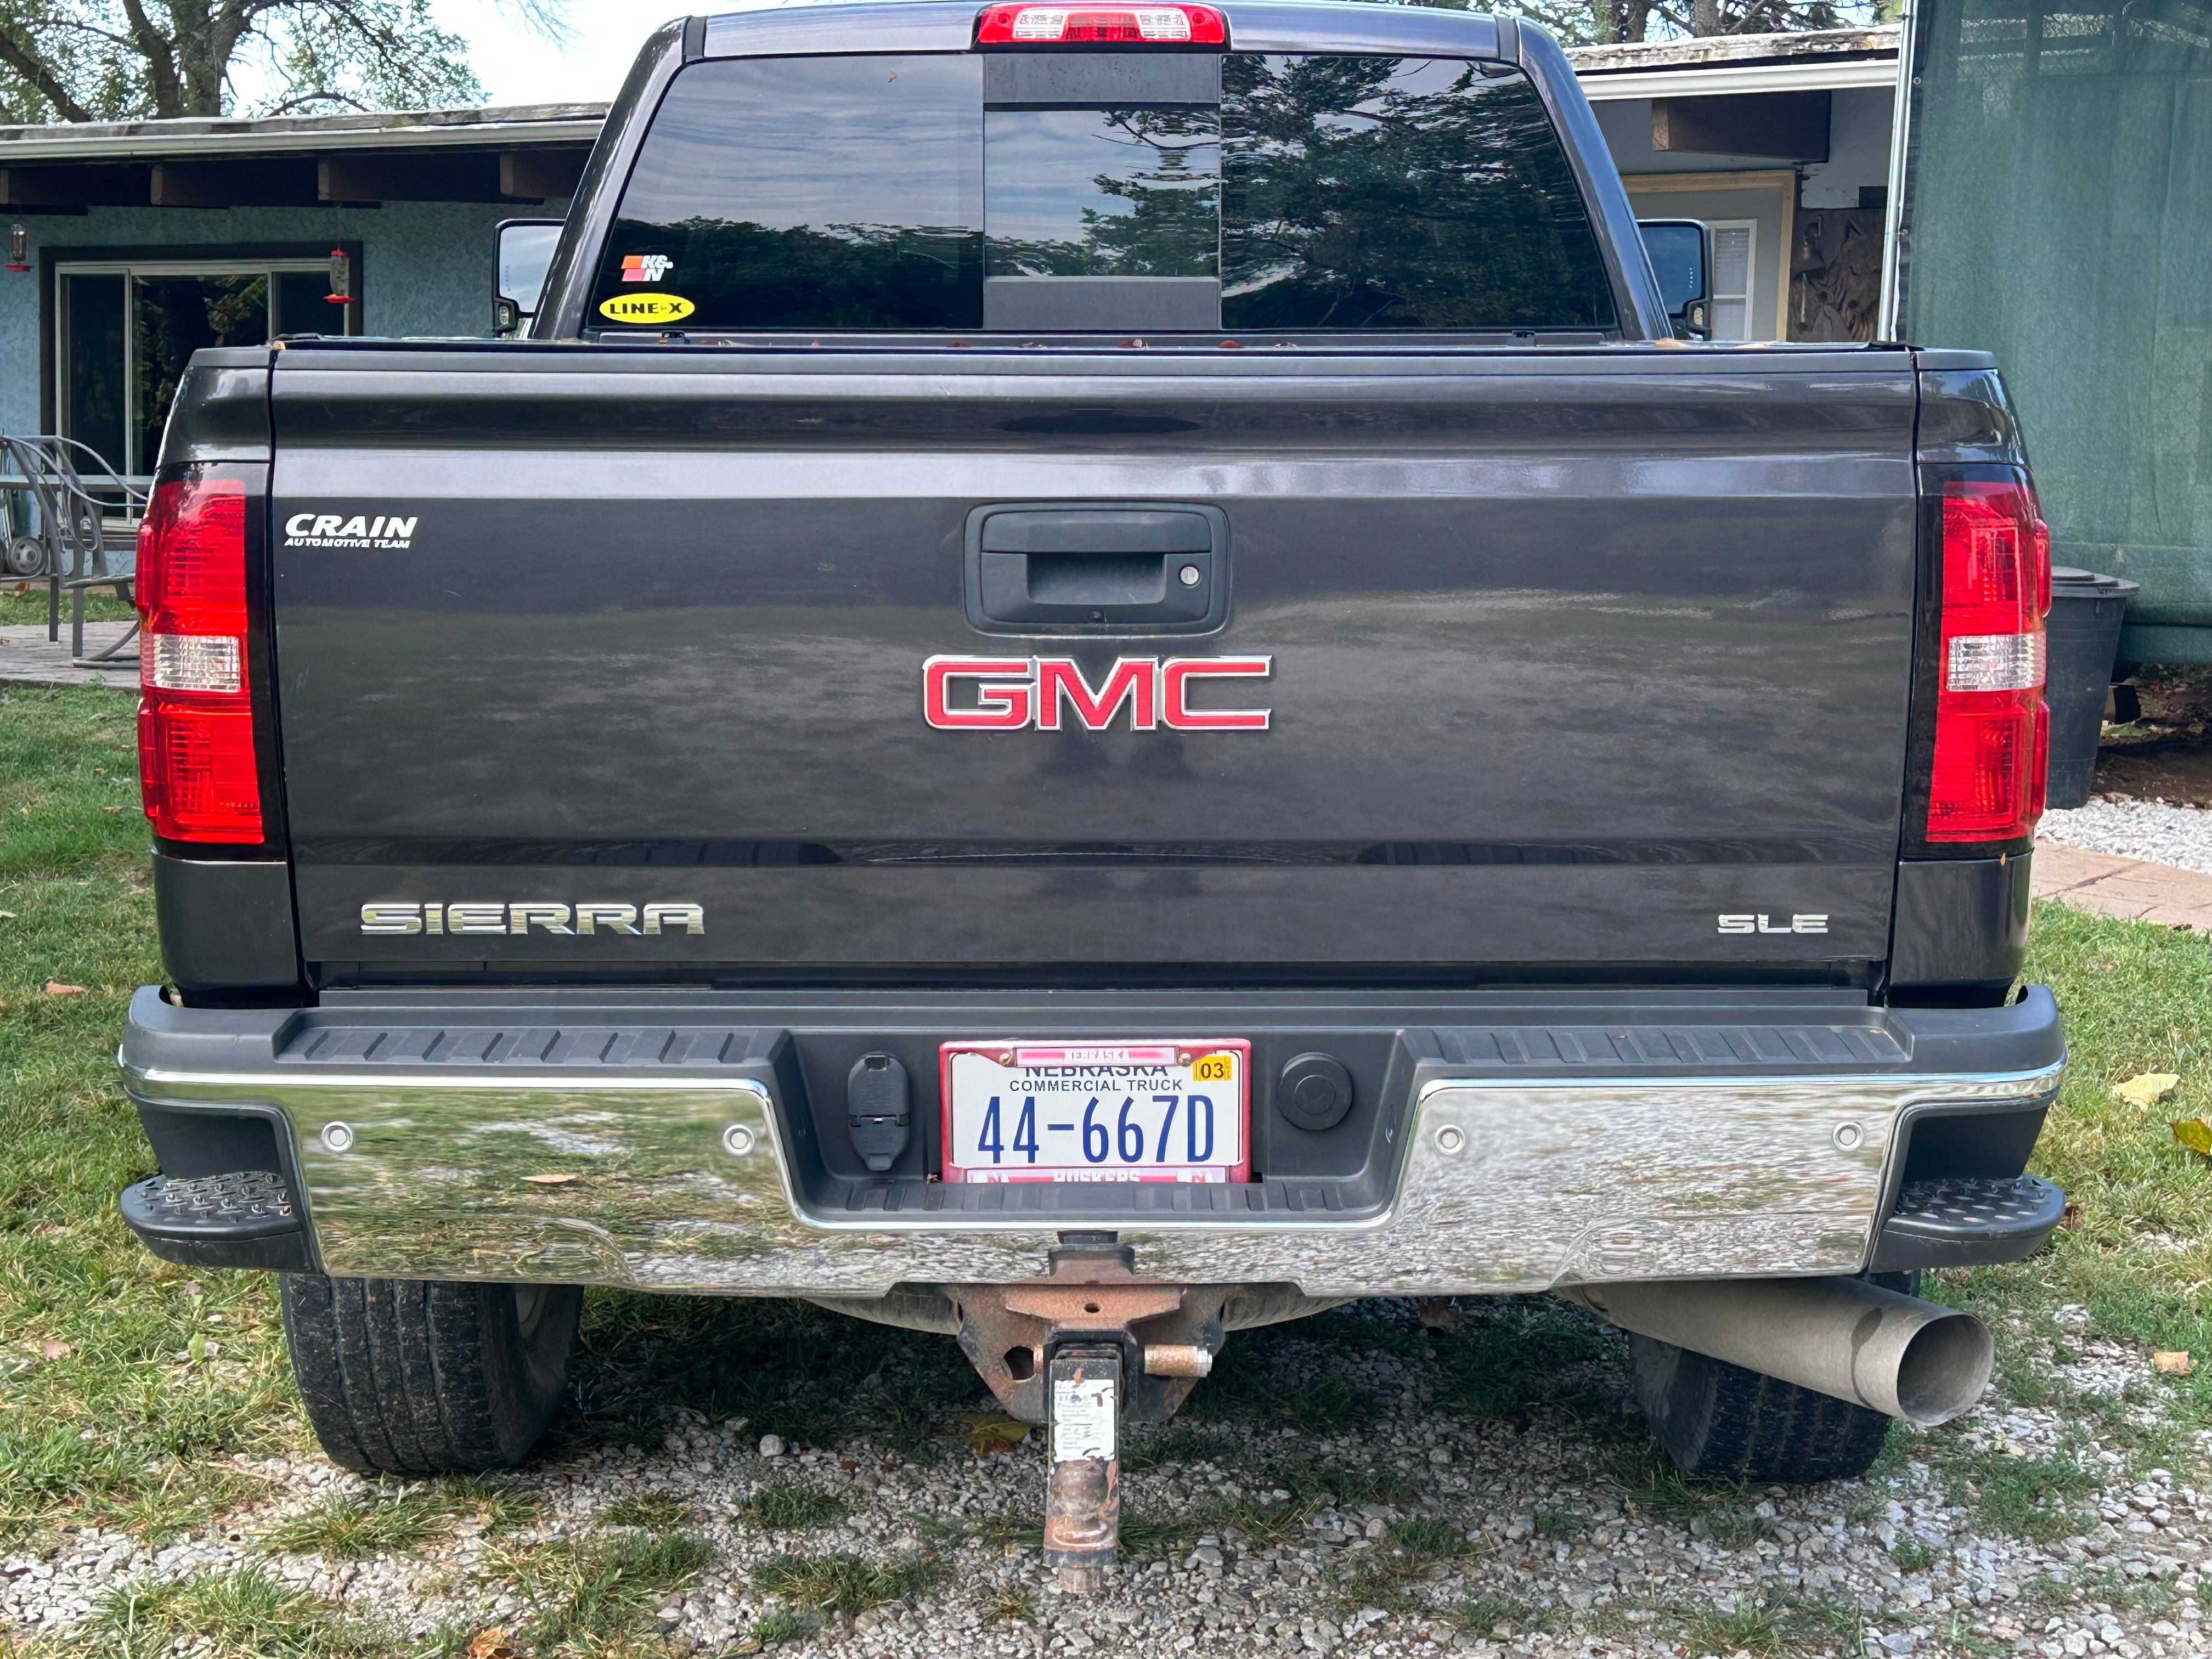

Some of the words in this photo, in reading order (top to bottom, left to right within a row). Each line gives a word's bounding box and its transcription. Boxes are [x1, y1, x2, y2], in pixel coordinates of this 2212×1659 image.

[610, 303, 685, 314] LINE-X
[285, 514, 418, 538] CRAIN
[284, 538, 371, 548] AUTOMOTIVE
[374, 539, 411, 549] TEAM
[922, 654, 1272, 731] GMC
[361, 903, 705, 935] SIERRA
[1717, 913, 1829, 933] SLE
[1063, 1049, 1131, 1063] NEBRASKA
[1200, 1062, 1224, 1079] 03
[1009, 1080, 1121, 1092] COMMERCIAL
[1129, 1079, 1183, 1092] TRUCK
[977, 1095, 1214, 1164] 44-667D
